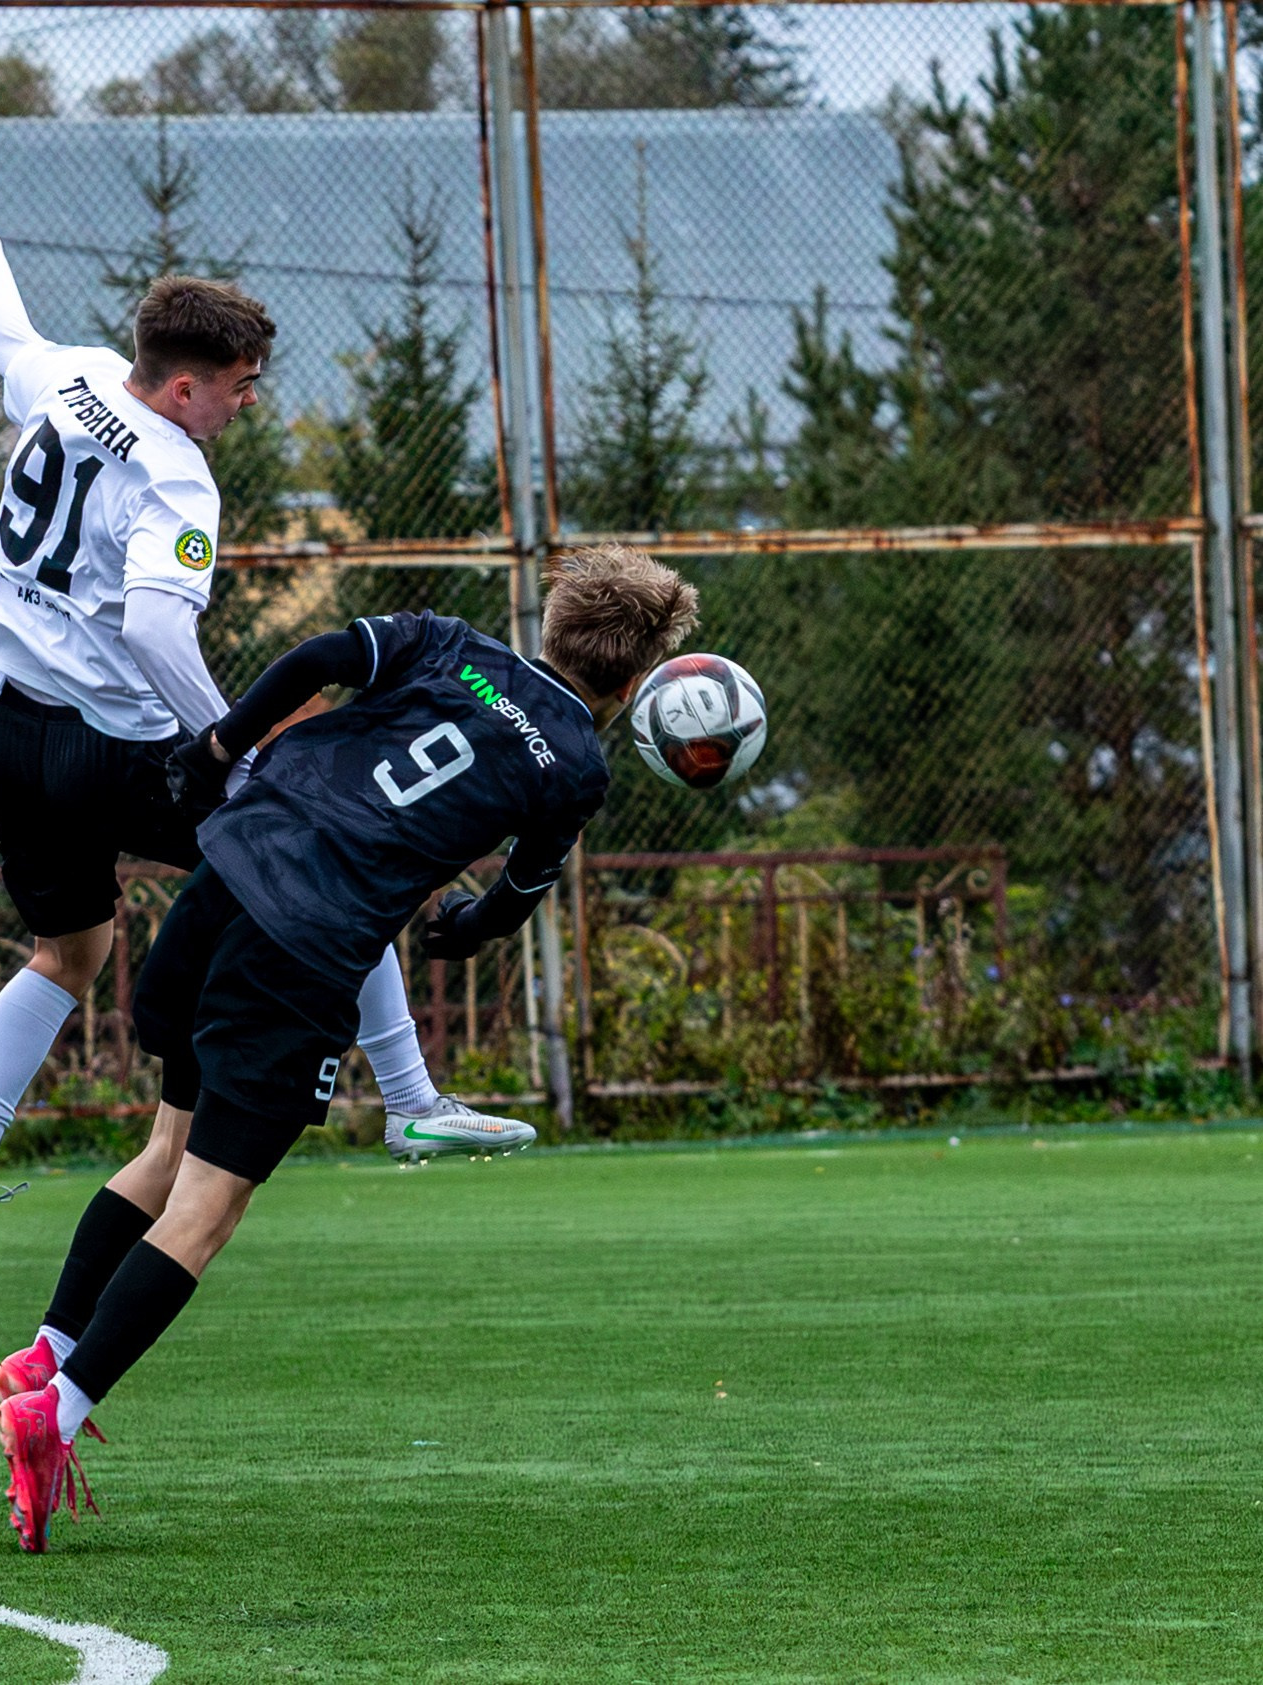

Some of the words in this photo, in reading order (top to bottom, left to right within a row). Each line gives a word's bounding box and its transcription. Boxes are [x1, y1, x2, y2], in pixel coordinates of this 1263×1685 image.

[459, 664, 556, 768] VINSERVICE
[373, 721, 475, 807] 9
[315, 1057, 340, 1101] 9
